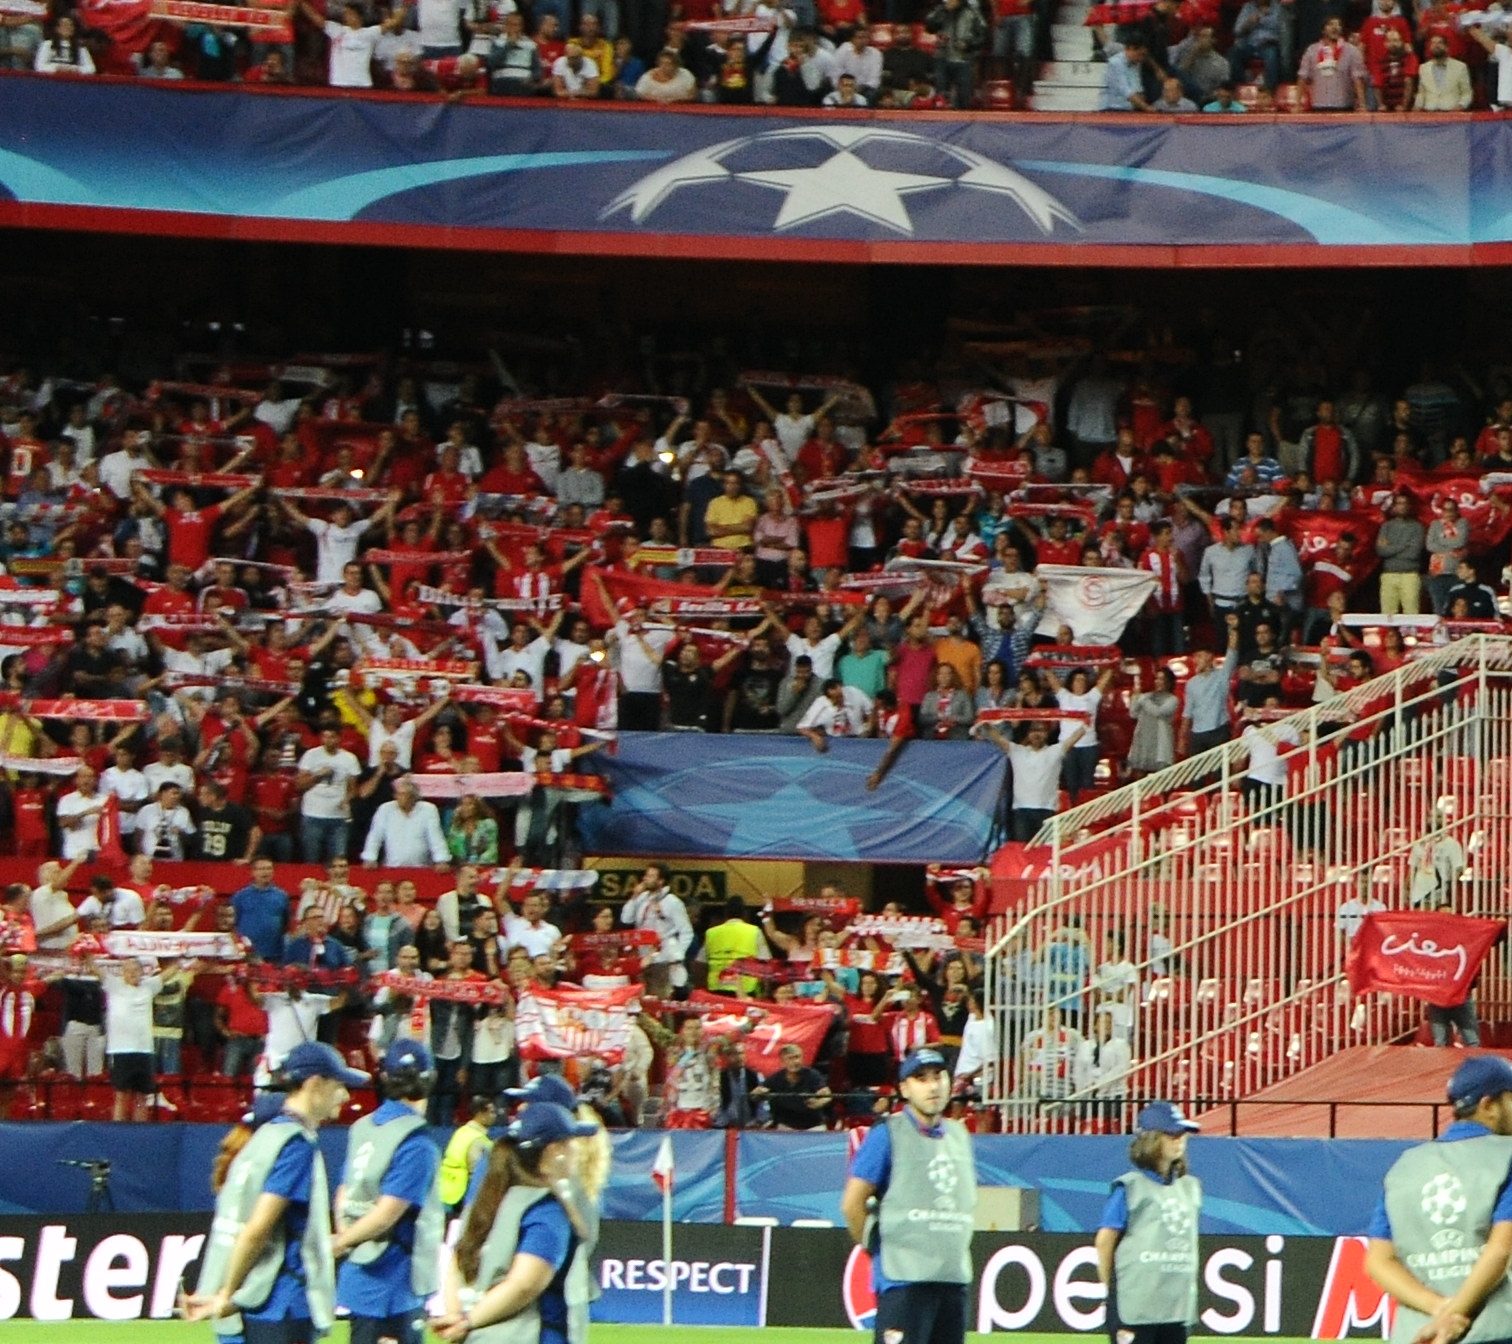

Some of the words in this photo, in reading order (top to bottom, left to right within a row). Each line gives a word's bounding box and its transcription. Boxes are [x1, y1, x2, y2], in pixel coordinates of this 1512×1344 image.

[601, 872, 716, 897] SADA
[602, 1259, 755, 1294] RESPECT
[977, 1235, 1283, 1334] pesi
